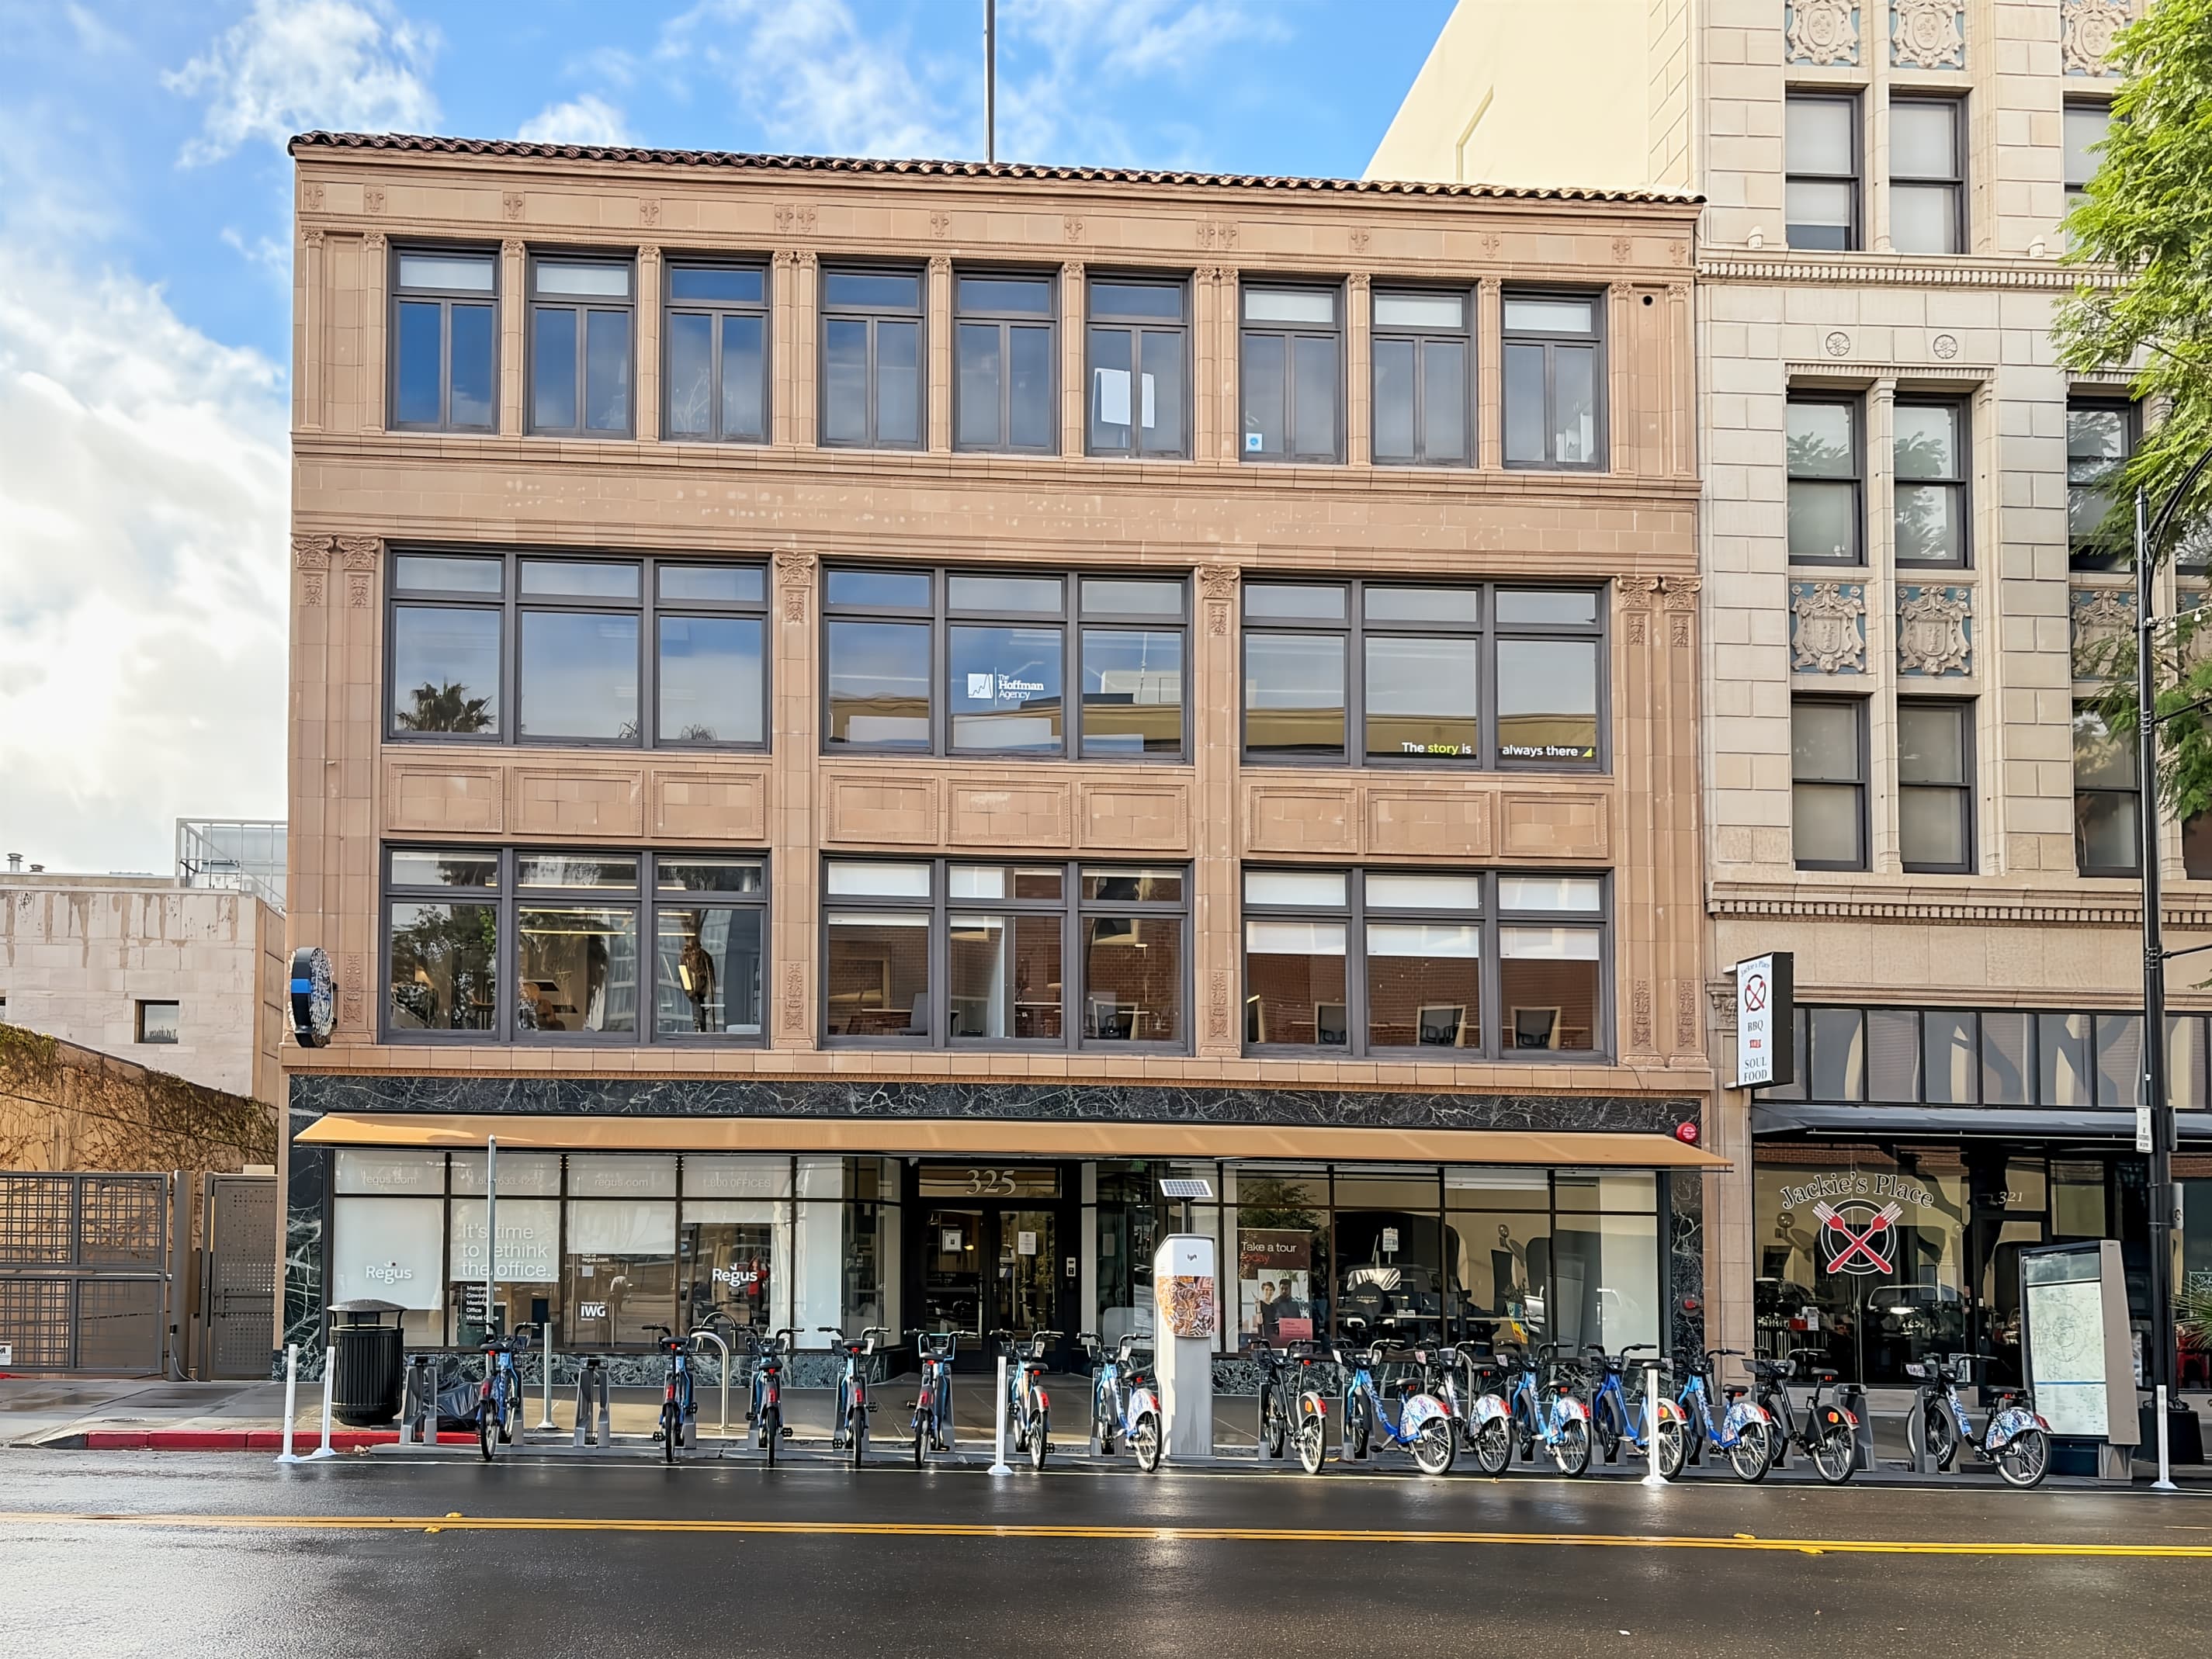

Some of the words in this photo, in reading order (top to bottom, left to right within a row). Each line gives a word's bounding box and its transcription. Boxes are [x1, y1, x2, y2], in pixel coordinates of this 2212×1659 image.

[998, 681, 1045, 691] Hoffman
[998, 690, 1031, 701] Agency
[1402, 742, 1425, 753] The
[1427, 743, 1459, 756] story
[1461, 743, 1472, 753] is
[1502, 744, 1543, 757] always
[1546, 745, 1579, 757] there
[1747, 1019, 1764, 1032] BBQ
[1744, 1056, 1767, 1069] SOUL
[1744, 1070, 1768, 1082] FOOD
[966, 1169, 1017, 1196] 325
[1780, 1171, 1868, 1210] Jackie's
[1874, 1173, 1934, 1209] Place
[1998, 1191, 2023, 1204] 321
[463, 1223, 488, 1240] It's
[463, 1242, 480, 1258] to
[493, 1242, 548, 1259] ethink
[1241, 1242, 1265, 1252] Take
[1267, 1244, 1274, 1252] a
[1276, 1243, 1297, 1253] tour
[366, 1260, 412, 1285] Regus
[461, 1260, 489, 1276] the
[496, 1261, 551, 1277] office.
[712, 1263, 758, 1287] Regus
[581, 1305, 606, 1318] IWG
